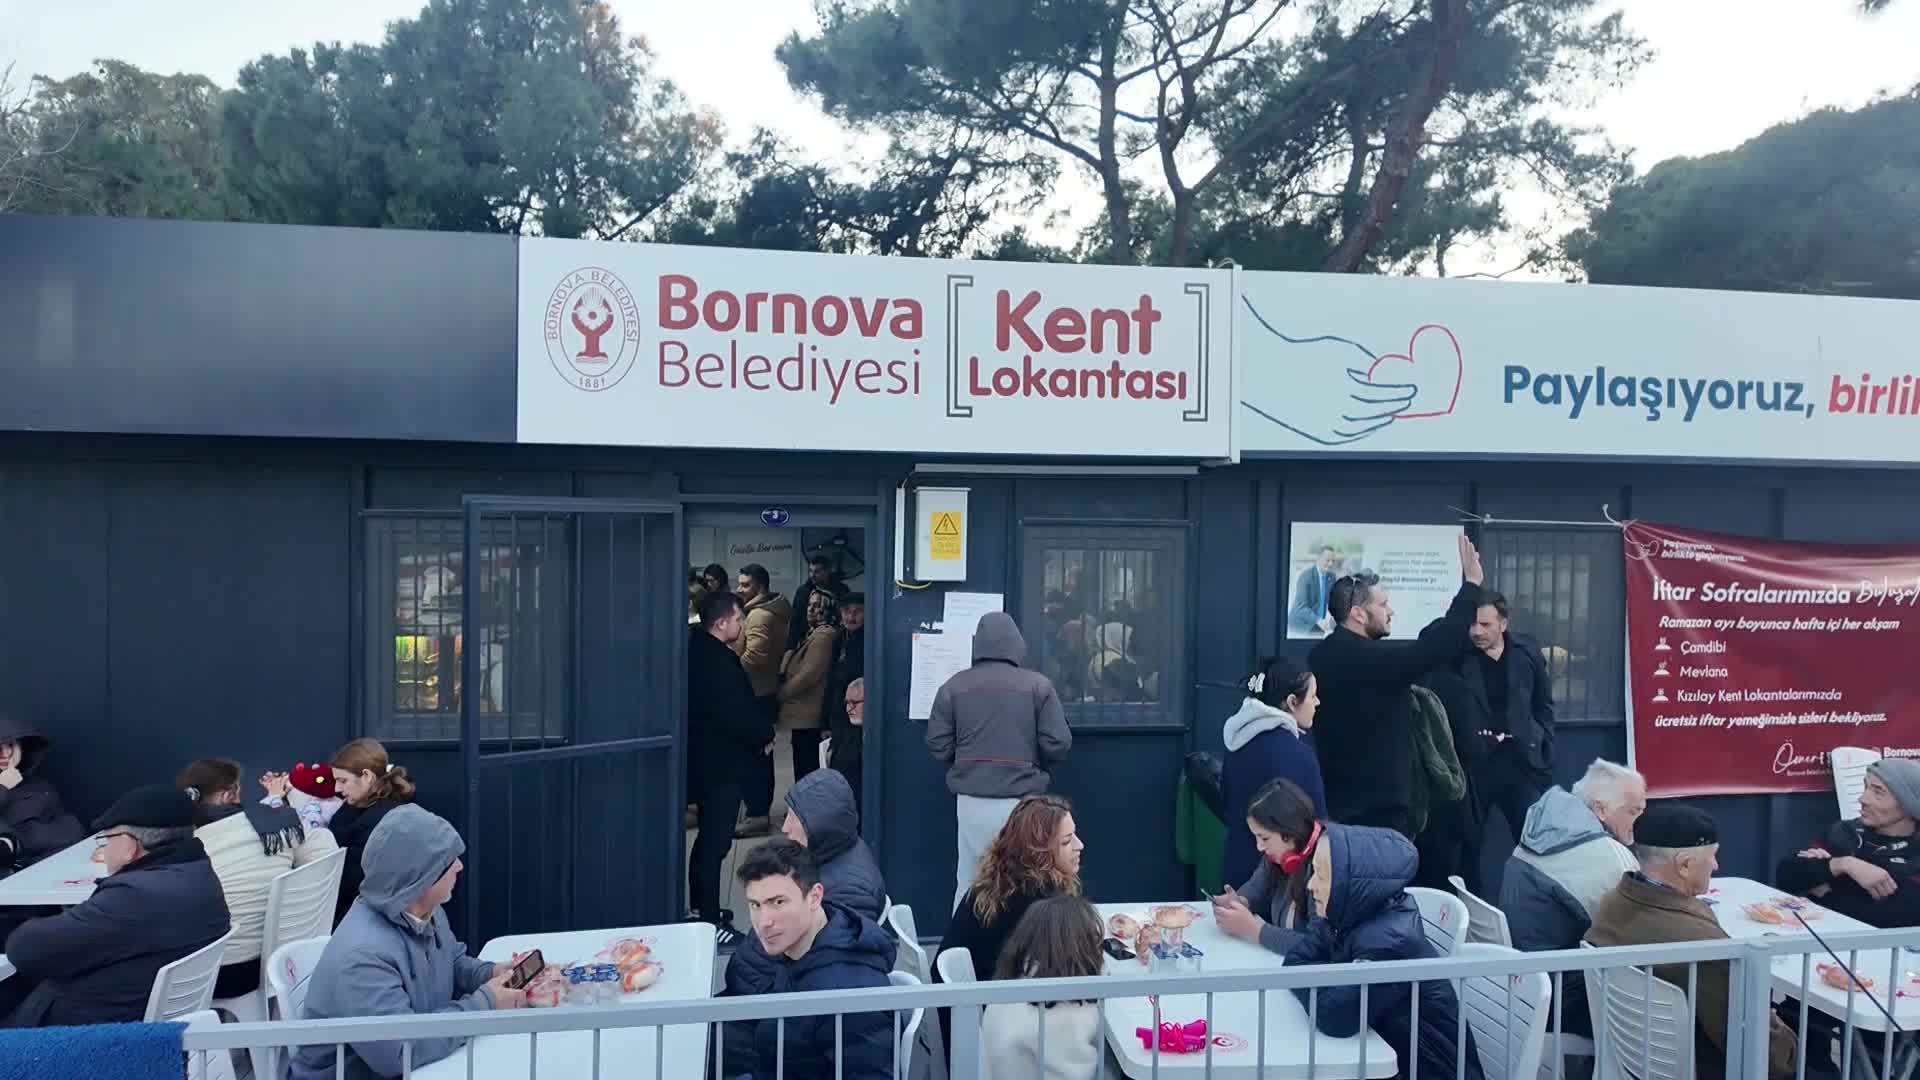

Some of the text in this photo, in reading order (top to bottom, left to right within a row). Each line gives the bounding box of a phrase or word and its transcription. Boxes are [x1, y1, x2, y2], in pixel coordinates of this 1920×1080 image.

[547, 272, 585, 341] BORNOVA
[658, 274, 923, 340] Bornova
[996, 289, 1162, 354] Kent
[579, 377, 605, 388] 1881
[658, 340, 921, 405] Belediyesi
[969, 355, 1187, 400] Lokantası
[1504, 365, 1815, 422] Paylaşıyoruz,
[1652, 575, 1695, 601] İftar
[1700, 581, 1850, 604] Sofralarımızda
[1659, 615, 1900, 632] Ramazan ayı boyunca hafta içi her akşam
[1680, 640, 1726, 655] Çamdibi
[1680, 665, 1728, 678] Mevlana
[1677, 688, 1842, 705] Kızılay Kent Lokantalarımızda
[1655, 714, 1698, 727] ücretsiz
[1699, 713, 1726, 726] iftar
[1726, 712, 1797, 729] yemeğimizle
[1798, 711, 1829, 724] sizleri
